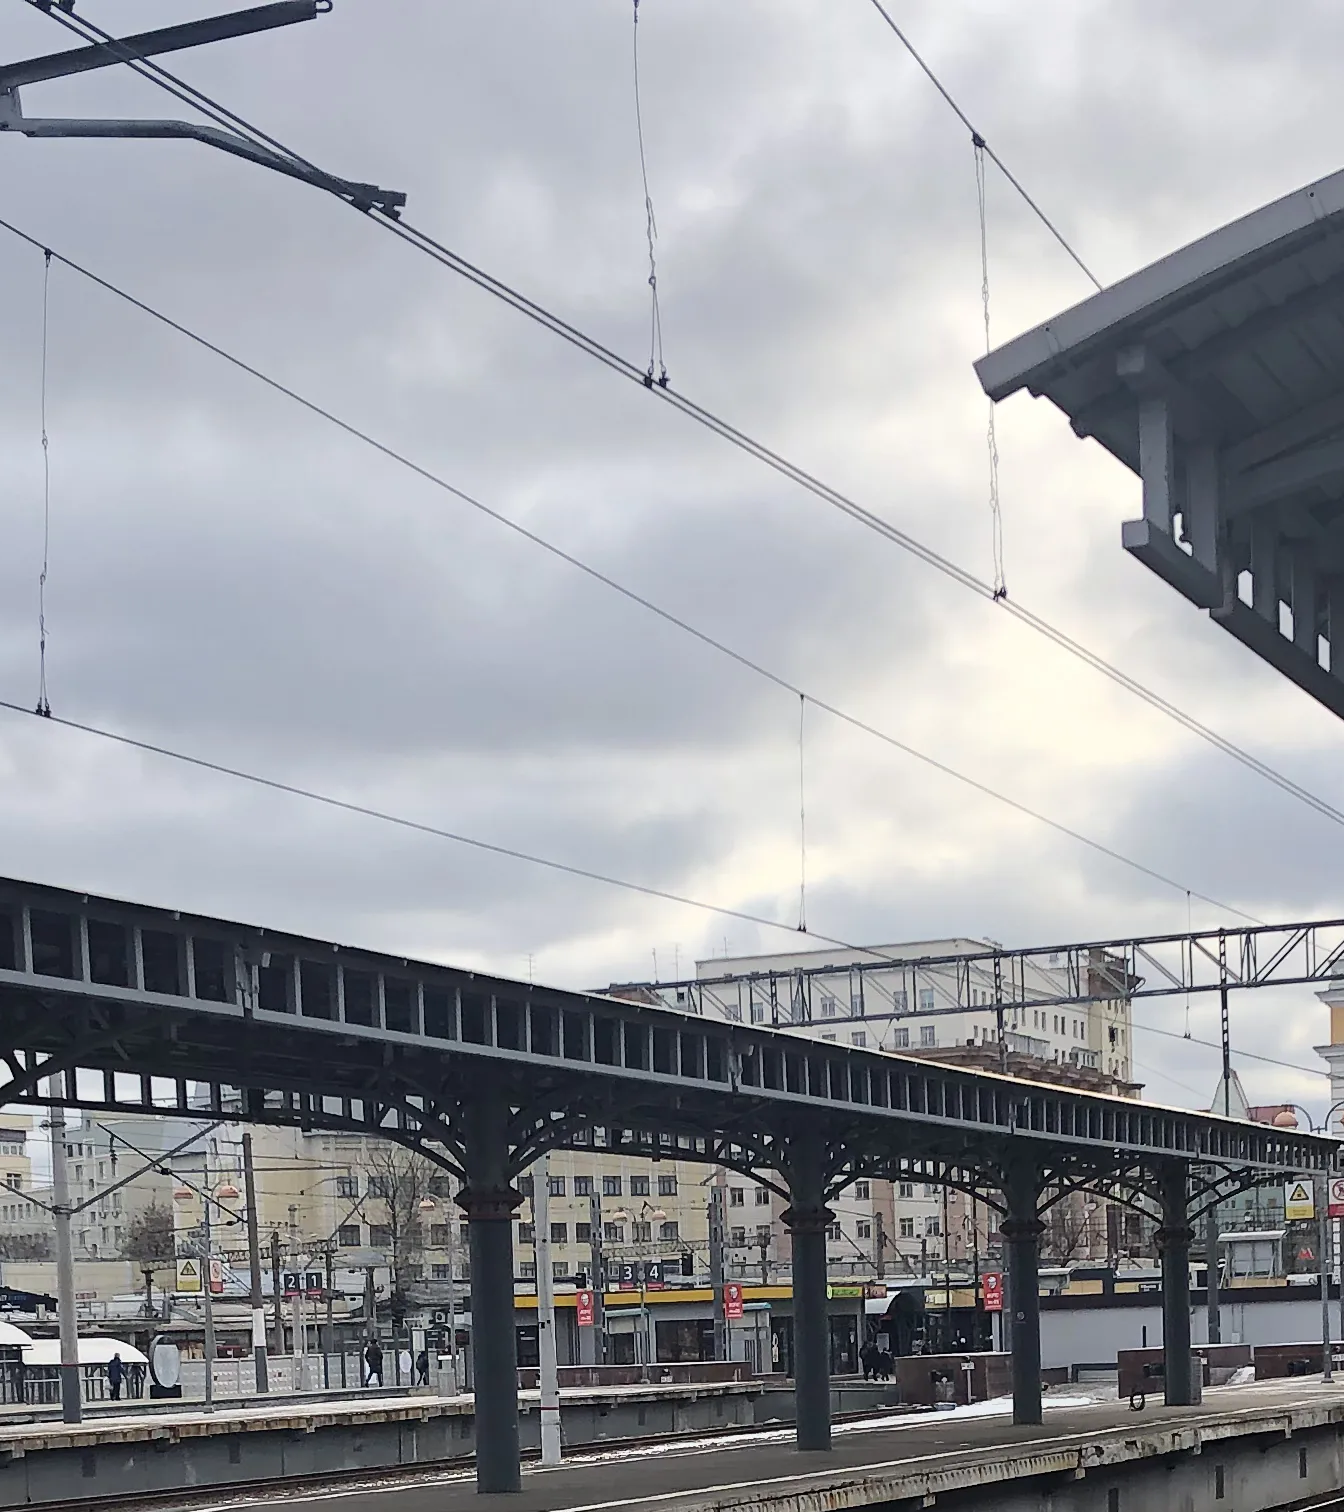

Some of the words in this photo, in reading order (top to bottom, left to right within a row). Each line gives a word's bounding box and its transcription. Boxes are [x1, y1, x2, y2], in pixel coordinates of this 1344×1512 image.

[623, 1266, 633, 1280] 3
[649, 1265, 659, 1280] 4
[287, 1275, 297, 1289] 2
[310, 1274, 318, 1287] 1
